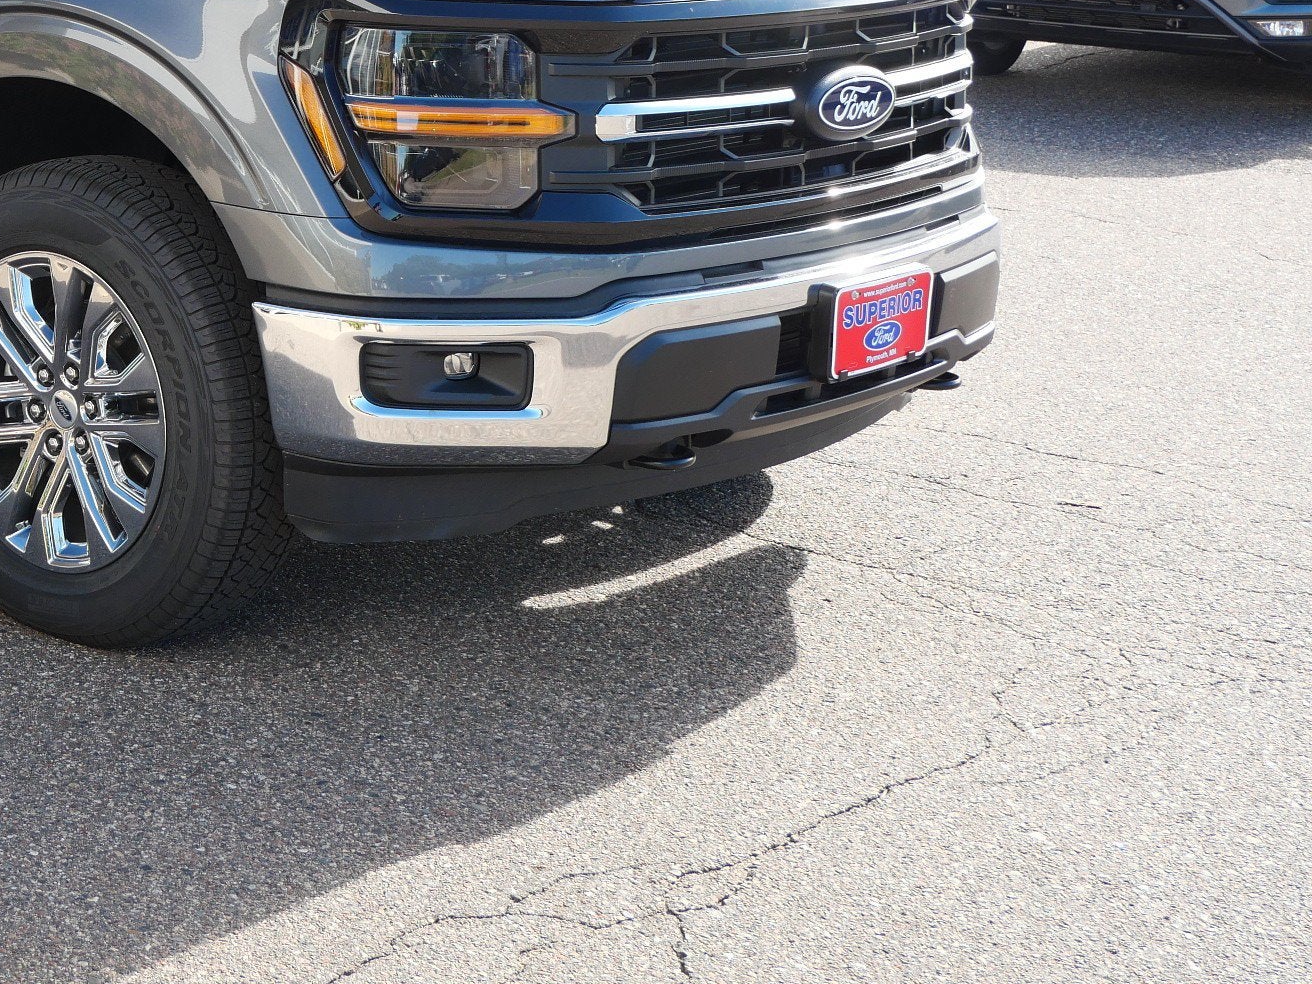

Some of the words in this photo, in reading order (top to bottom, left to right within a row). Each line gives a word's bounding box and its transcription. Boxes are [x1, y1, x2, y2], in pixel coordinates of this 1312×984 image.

[834, 85, 881, 122] Ford
[863, 281, 907, 298] www.superiorford.com
[843, 289, 923, 329] SUPERIOR
[871, 325, 895, 345] Ford
[114, 259, 194, 454] SCORPION
